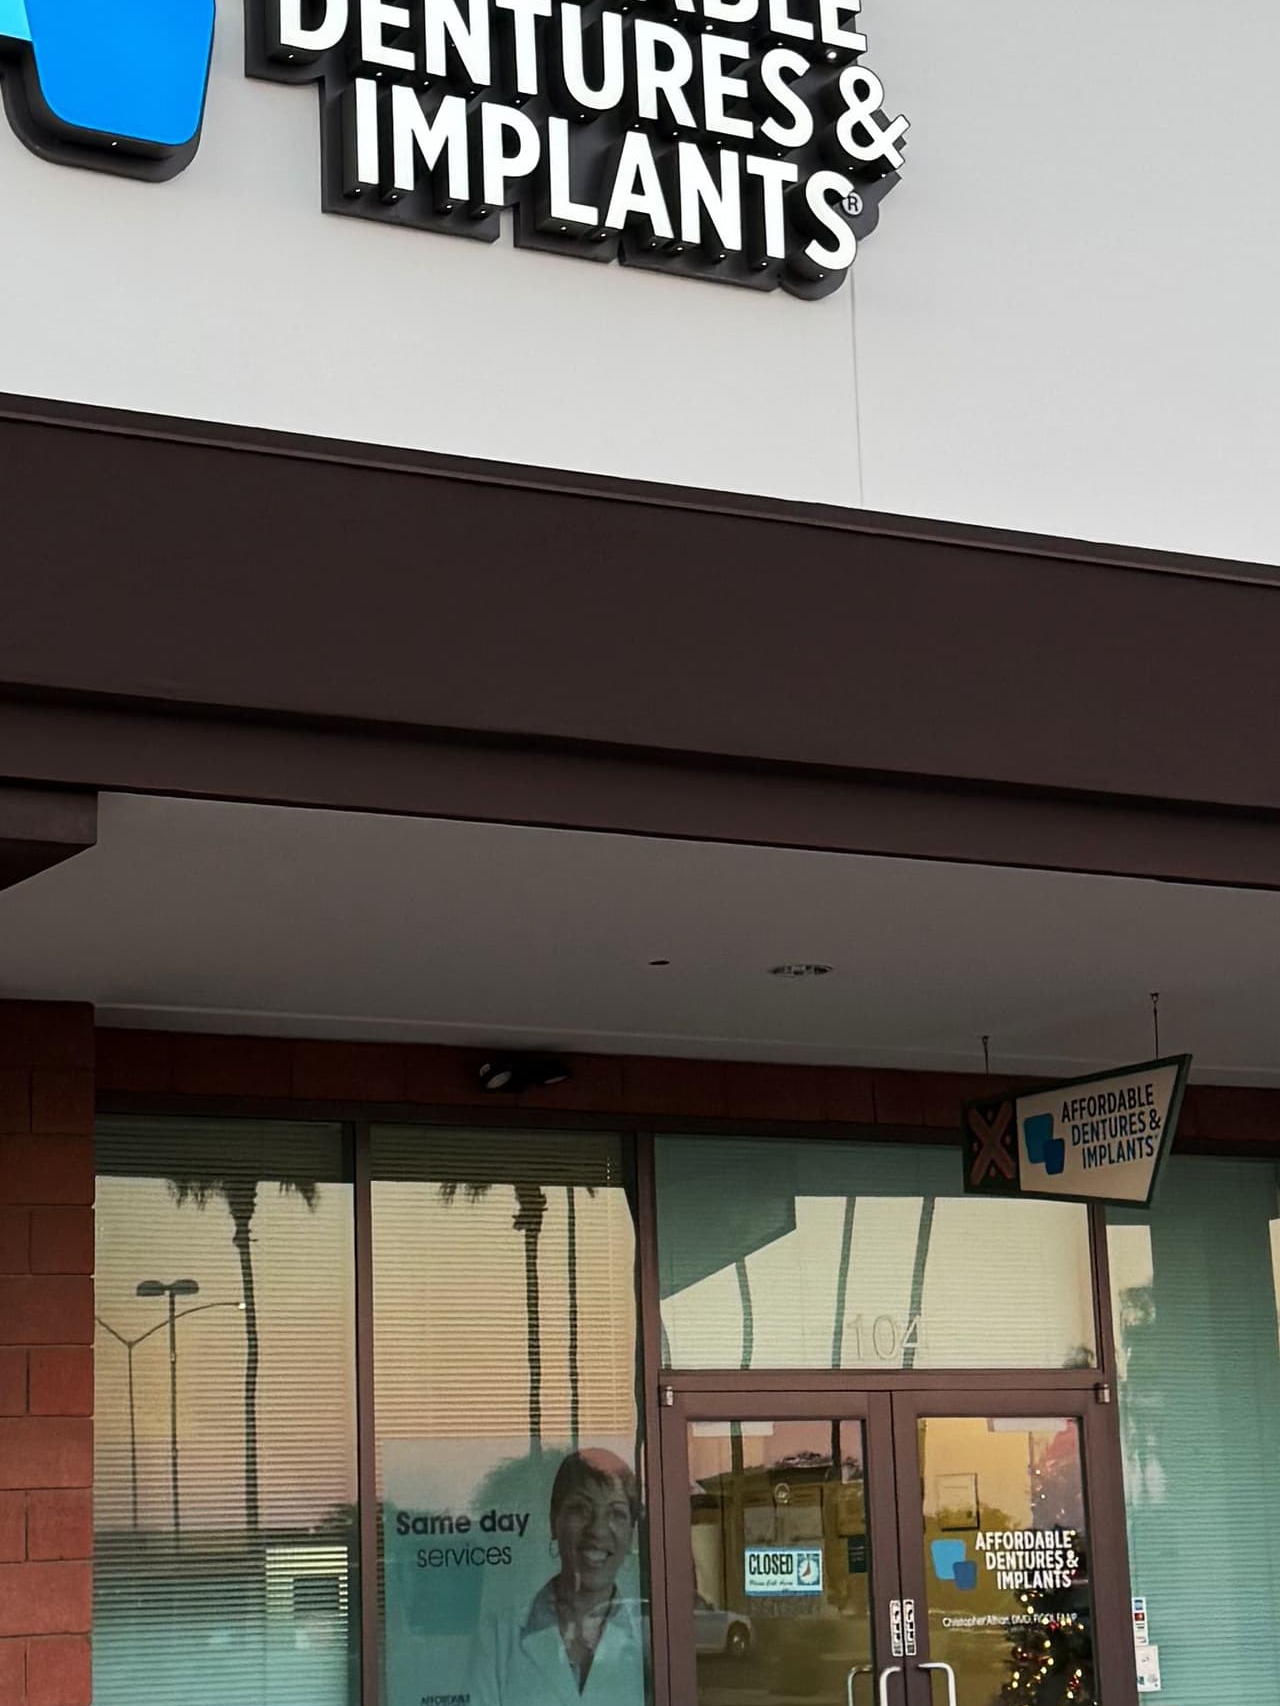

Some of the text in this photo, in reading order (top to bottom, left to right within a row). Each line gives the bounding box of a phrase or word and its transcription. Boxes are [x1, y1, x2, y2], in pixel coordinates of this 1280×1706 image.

[835, 65, 911, 170] &
[1062, 1083, 1154, 1123] AFFORDABLE
[1072, 1108, 1161, 1146] DENTURES &
[846, 1313, 927, 1361] 104
[396, 1509, 531, 1538] Same day
[975, 1530, 1073, 1550] AFFORDABLE
[416, 1541, 513, 1569] services
[748, 1553, 794, 1575] CLOSED
[985, 1550, 1079, 1570] DENTURES &
